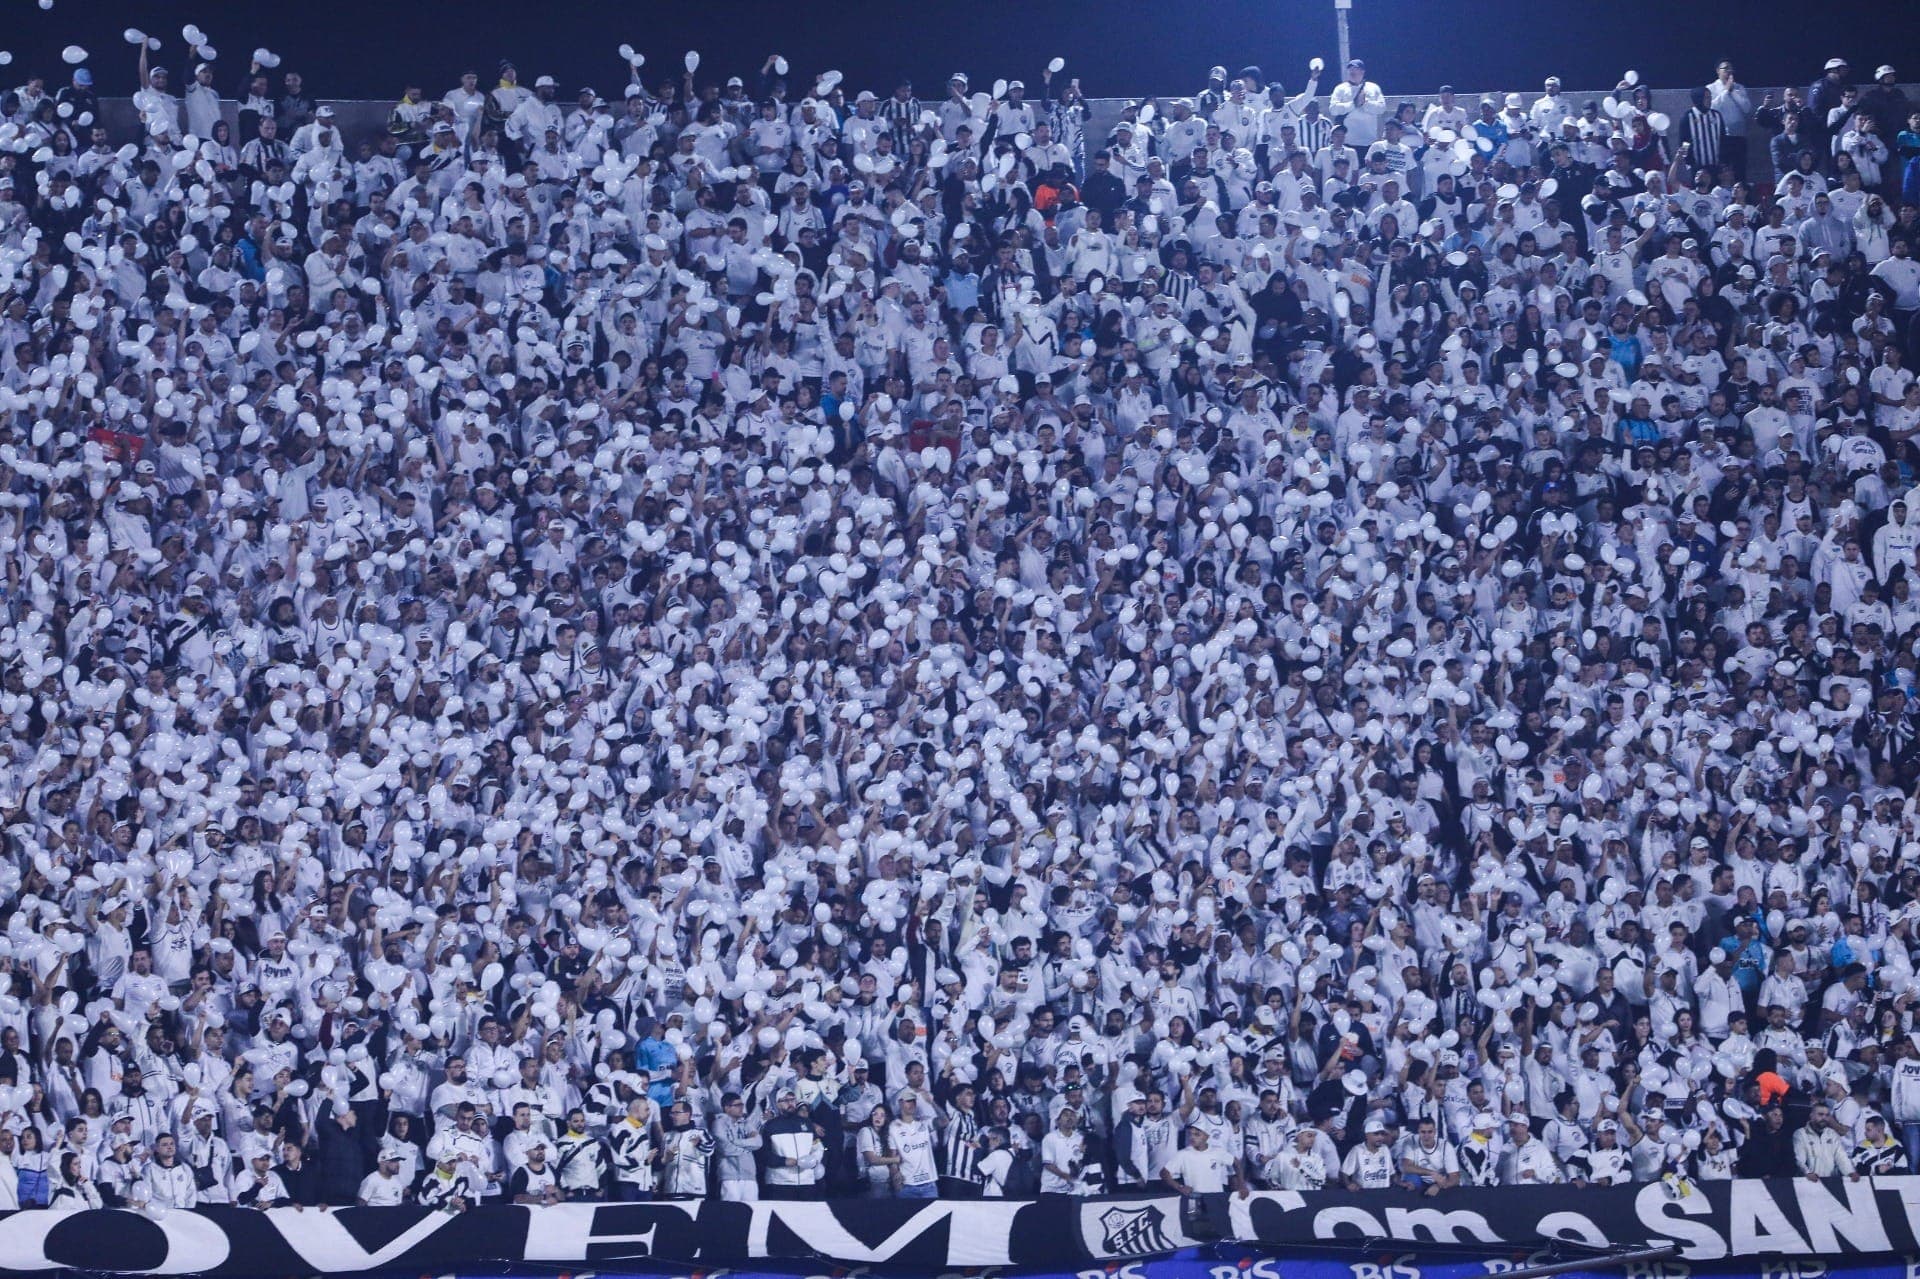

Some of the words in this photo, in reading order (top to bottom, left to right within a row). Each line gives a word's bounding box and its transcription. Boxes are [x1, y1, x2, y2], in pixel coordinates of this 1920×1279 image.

[264, 964, 292, 978] JOVEM
[1443, 1054, 1457, 1062] SFC
[1364, 1168, 1388, 1182] Coca-Cola
